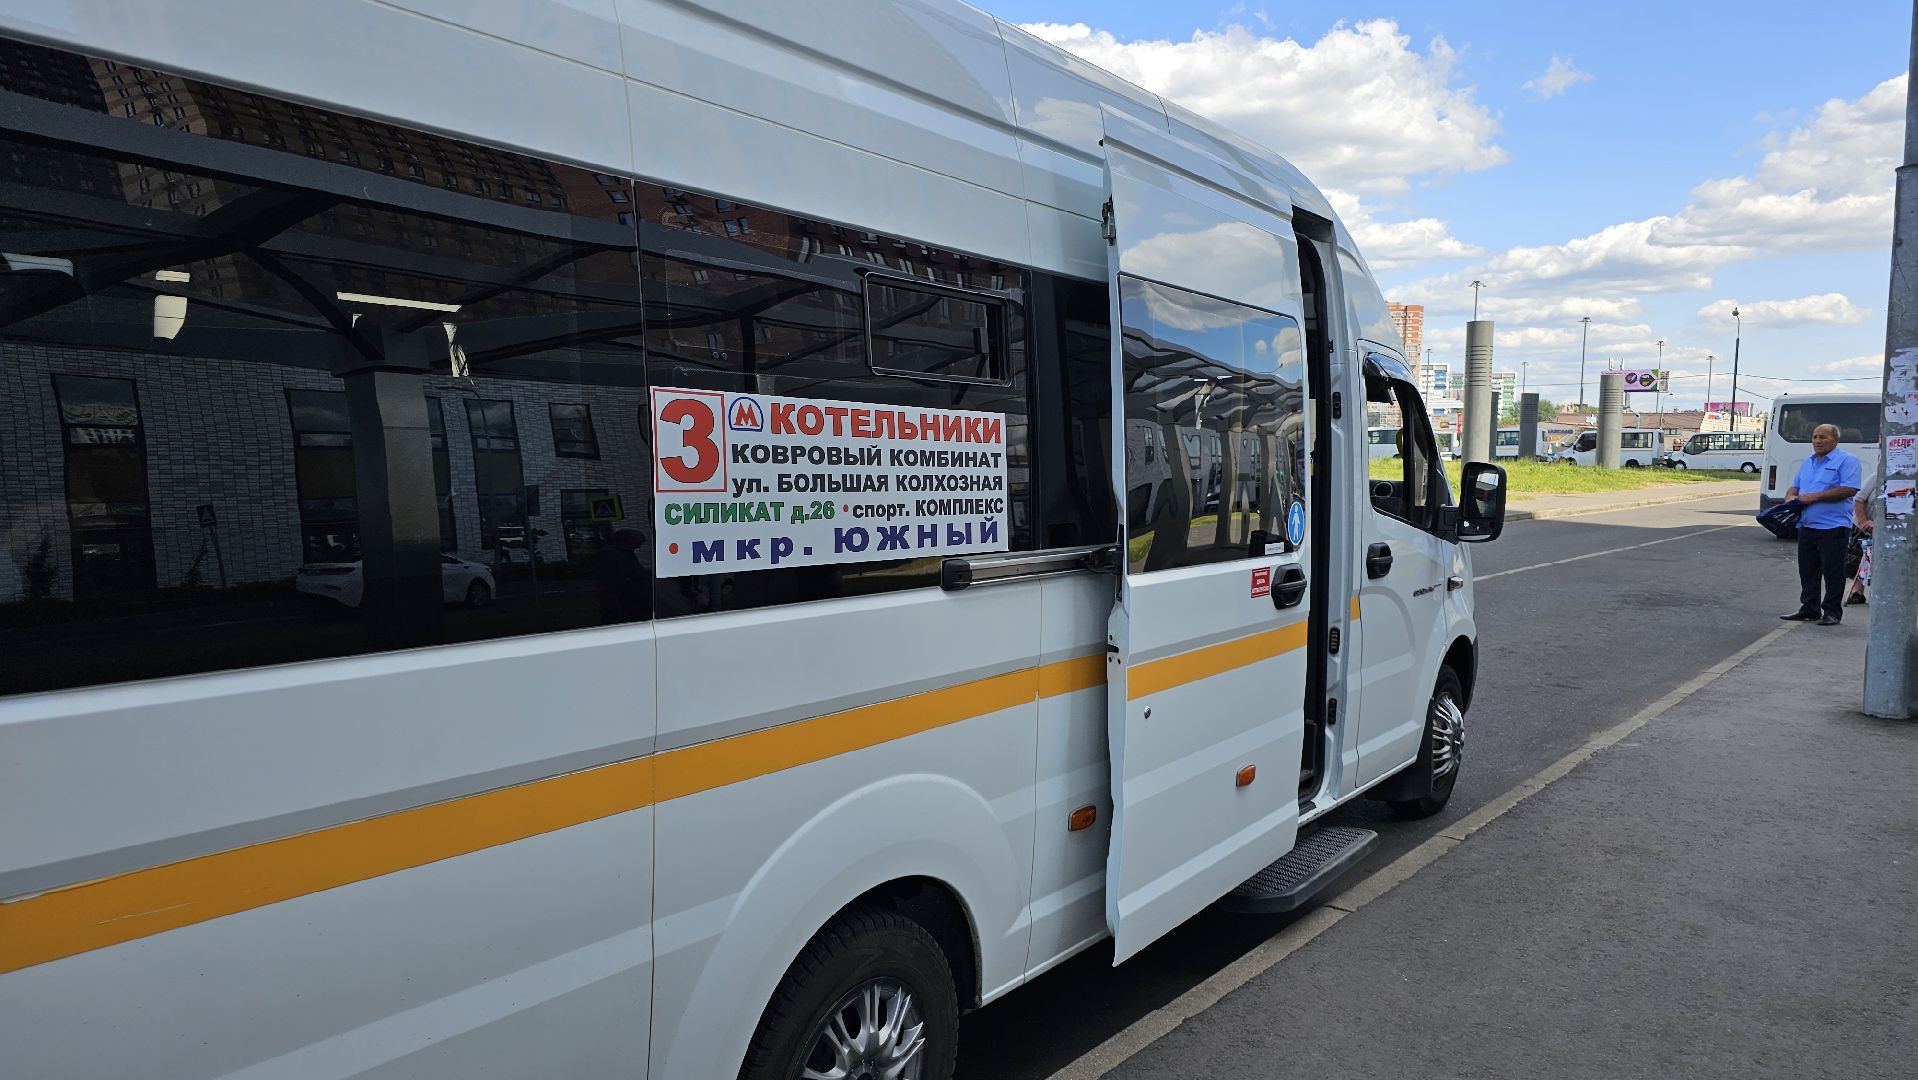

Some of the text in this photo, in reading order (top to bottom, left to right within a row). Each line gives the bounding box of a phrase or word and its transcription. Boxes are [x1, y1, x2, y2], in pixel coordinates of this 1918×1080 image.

[770, 402, 1002, 444] КОТЕЛЬНИКИ
[659, 398, 720, 484] 3
[1888, 438, 1916, 449] КРЕДИТ
[731, 443, 1002, 469] КОВРОВЫЙ КОМБИНАТ
[732, 473, 1003, 498] ул. БОЛЬШАЯ КОЛХОЗНАЯ
[664, 500, 835, 525] СИЛИКАТ д.26
[852, 498, 1004, 521] спорт. КОМПЛЕКС
[692, 516, 999, 565] мкр. ЮЖНЫЙ
